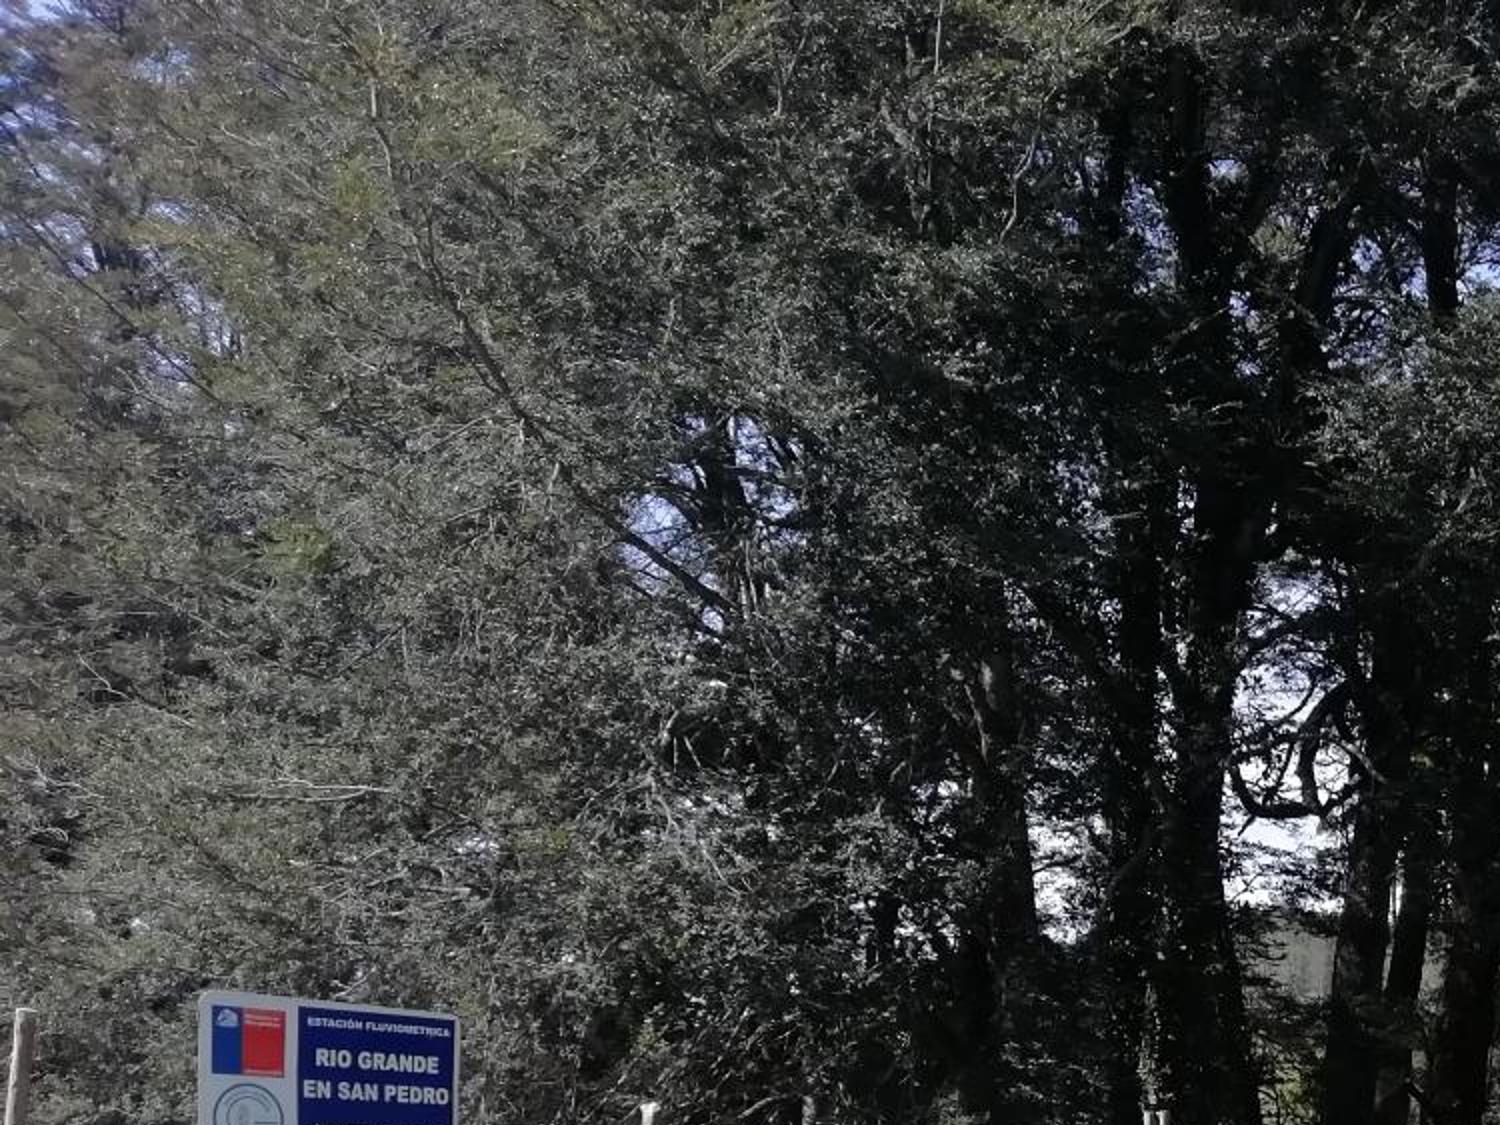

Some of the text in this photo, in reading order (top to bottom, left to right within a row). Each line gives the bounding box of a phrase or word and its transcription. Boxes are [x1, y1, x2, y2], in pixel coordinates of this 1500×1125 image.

[315, 1047, 439, 1074] RIO GRANDE
[303, 1080, 449, 1105] EN SAN PEDRO
